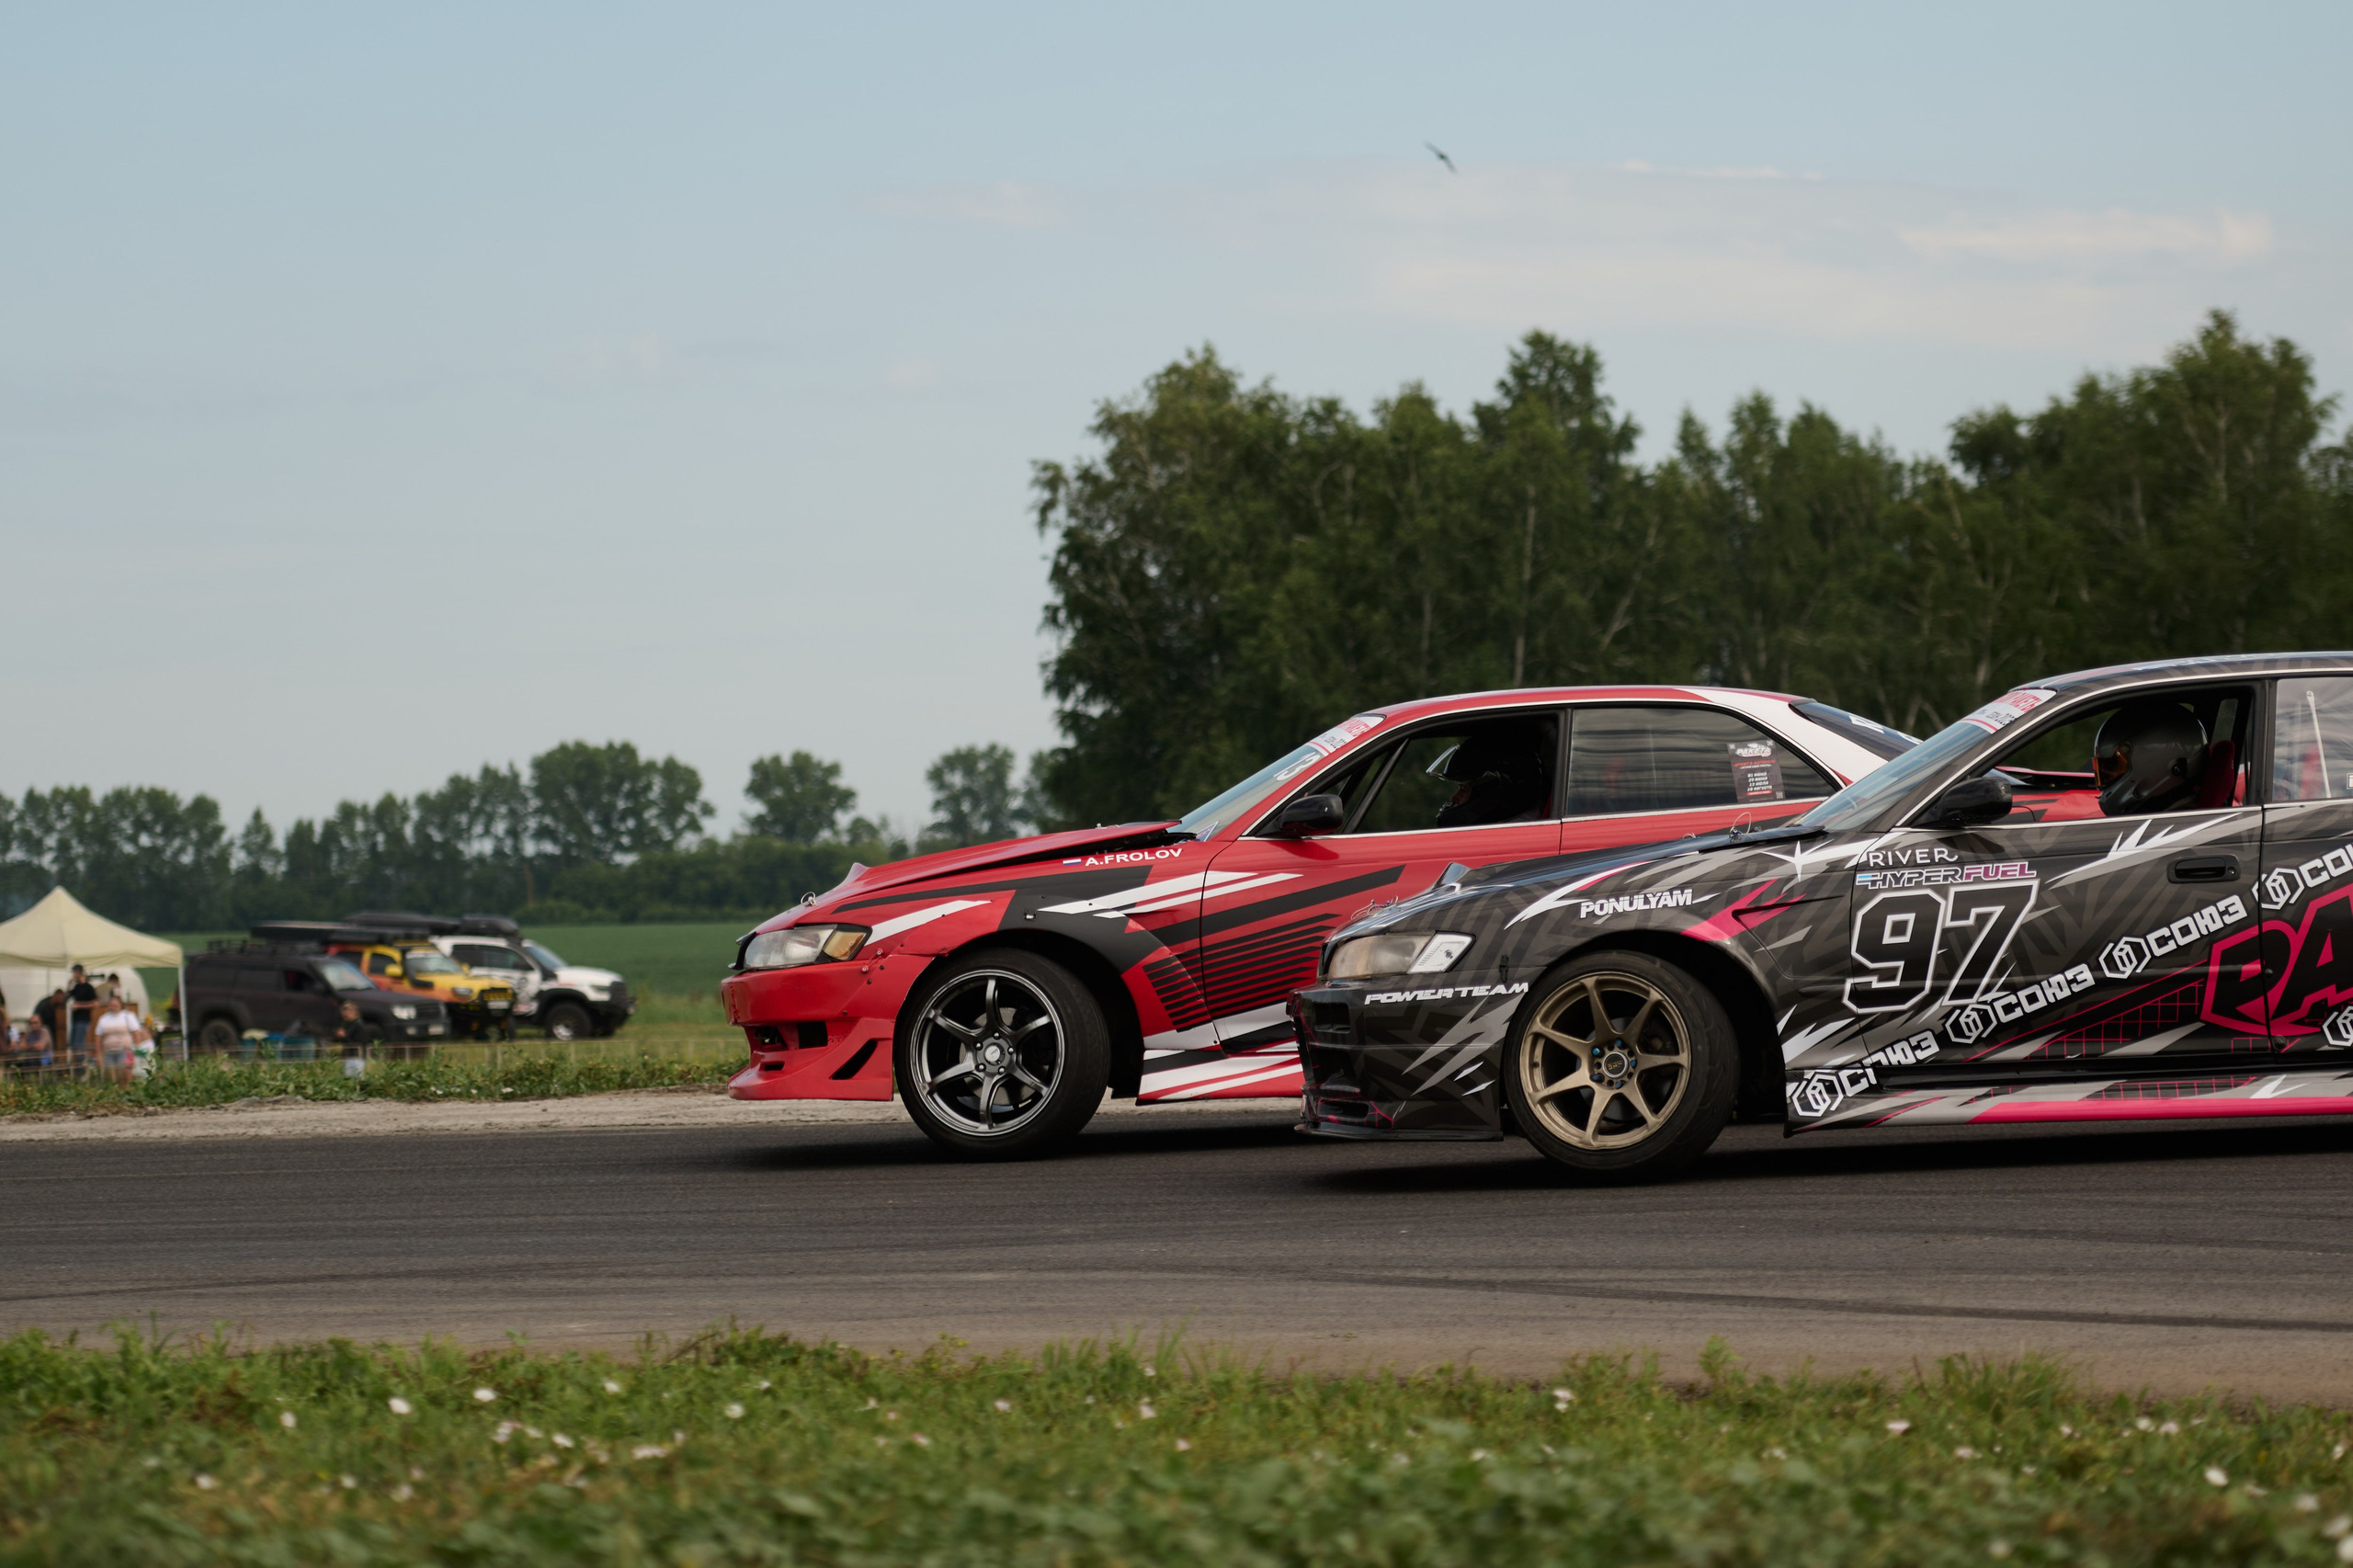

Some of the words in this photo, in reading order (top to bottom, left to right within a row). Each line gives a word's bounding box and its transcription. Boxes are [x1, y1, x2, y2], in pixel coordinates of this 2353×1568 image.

[1085, 848, 1183, 867] A.FROLOV
[1868, 847, 1959, 867] RIVER
[1580, 889, 1692, 919] PONULYAM
[1841, 879, 2040, 1014] 97
